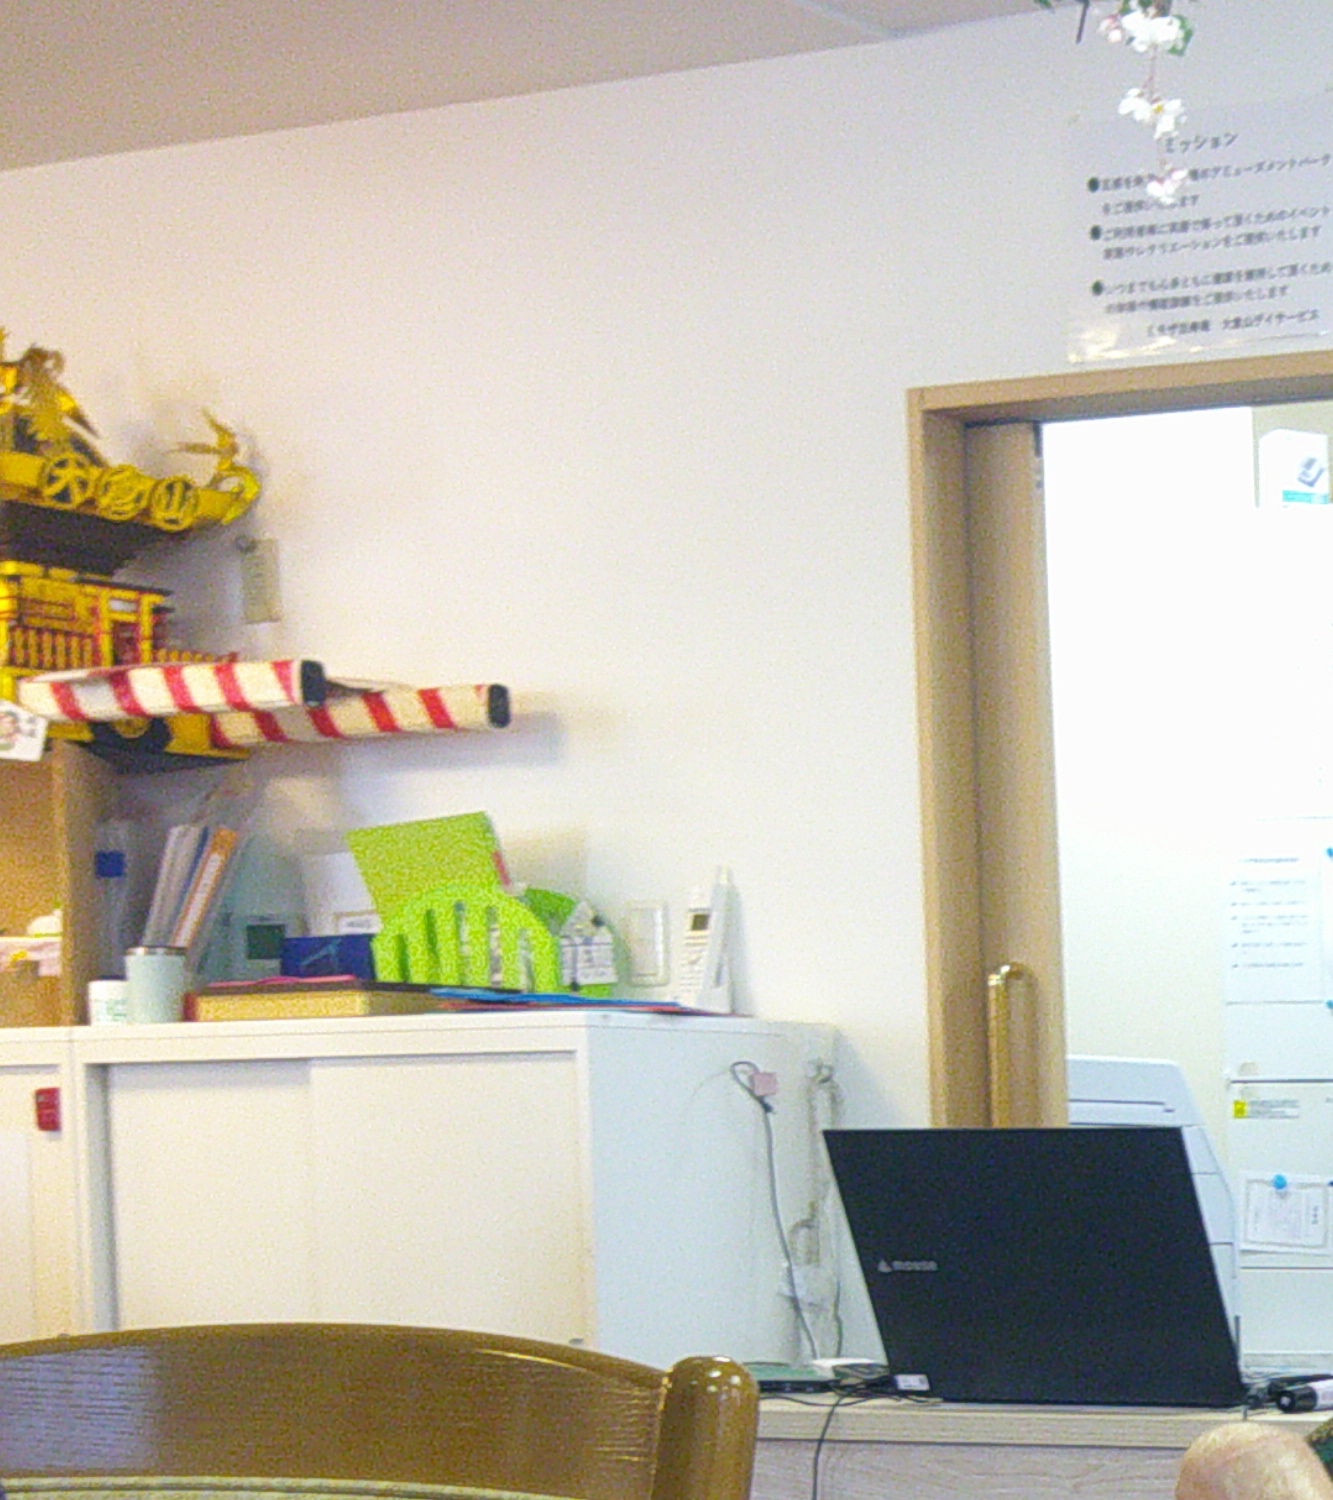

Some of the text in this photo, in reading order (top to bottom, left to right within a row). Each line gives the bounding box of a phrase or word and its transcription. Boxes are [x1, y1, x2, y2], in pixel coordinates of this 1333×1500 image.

[1163, 131, 1239, 154] ミッション
